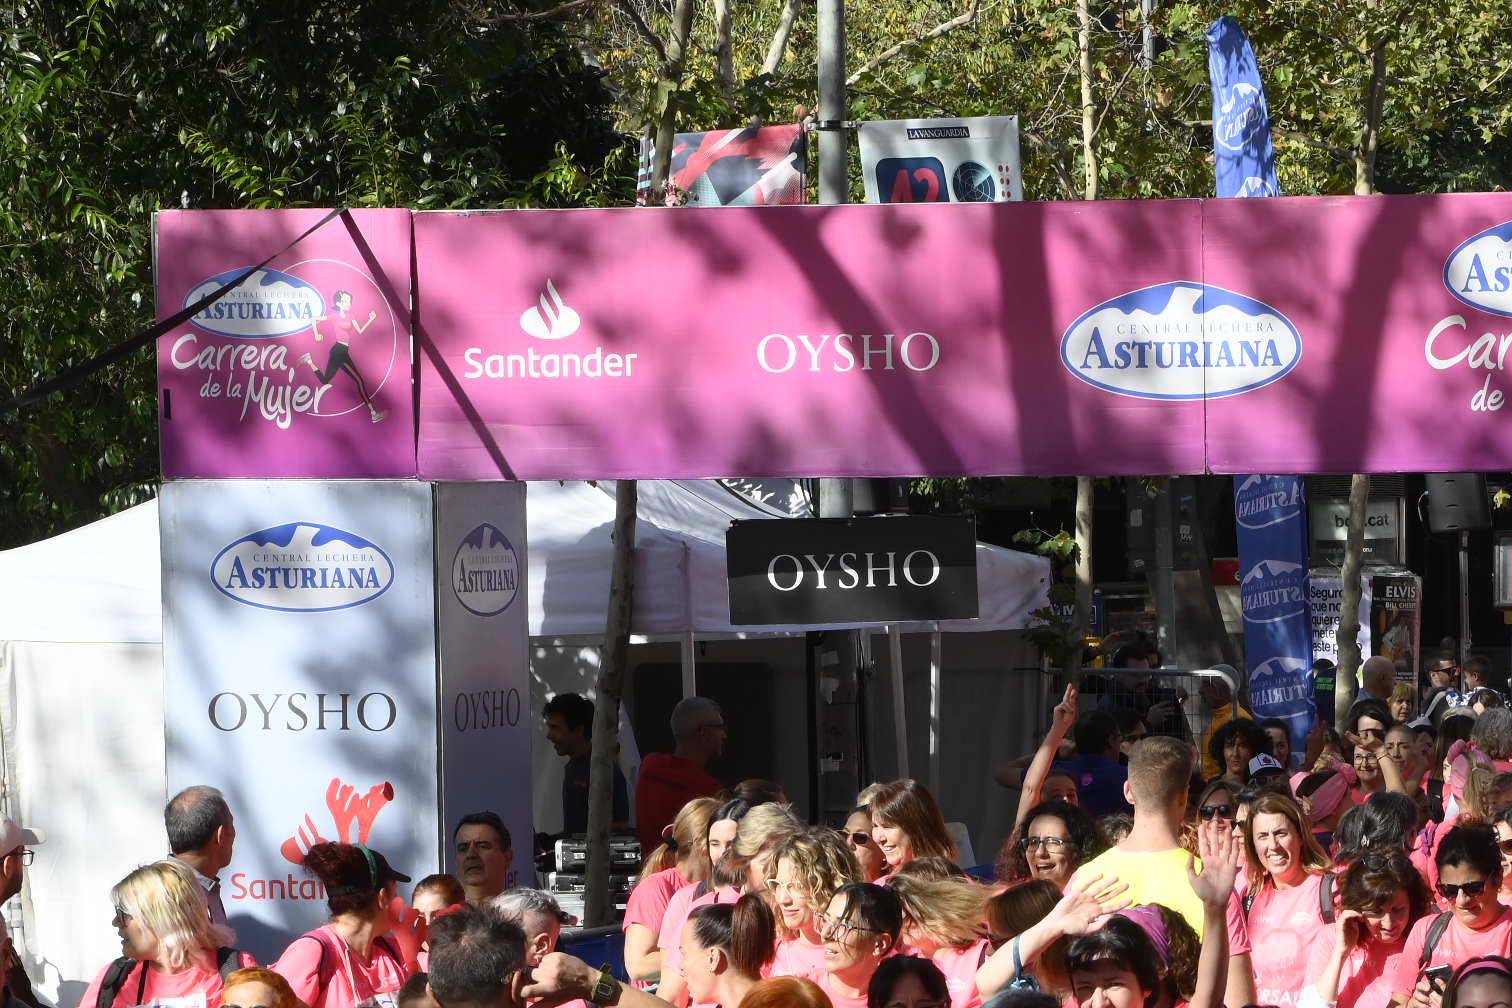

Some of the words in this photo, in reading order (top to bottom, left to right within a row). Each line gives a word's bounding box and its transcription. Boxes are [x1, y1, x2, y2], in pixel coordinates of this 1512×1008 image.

[1080, 326, 1283, 369] ASTURIANA
[1116, 323, 1191, 335] CENTRAL
[171, 333, 289, 371] Carrera
[464, 347, 637, 379] Santander
[757, 331, 940, 374] OYSHO
[200, 372, 221, 398] de
[226, 372, 242, 398] la
[240, 367, 333, 430] Mujer
[1470, 373, 1505, 412] de
[226, 555, 381, 589] ASTURIANA
[253, 554, 311, 562] CENTRAL
[317, 554, 375, 562] LECHERA
[458, 558, 516, 593] ASTURIANA
[767, 550, 941, 592] OYSHO
[1385, 586, 1416, 599] ELVIS
[208, 692, 397, 732] OYSHO
[454, 688, 521, 732] OYSHO
[231, 873, 329, 900] Santa
